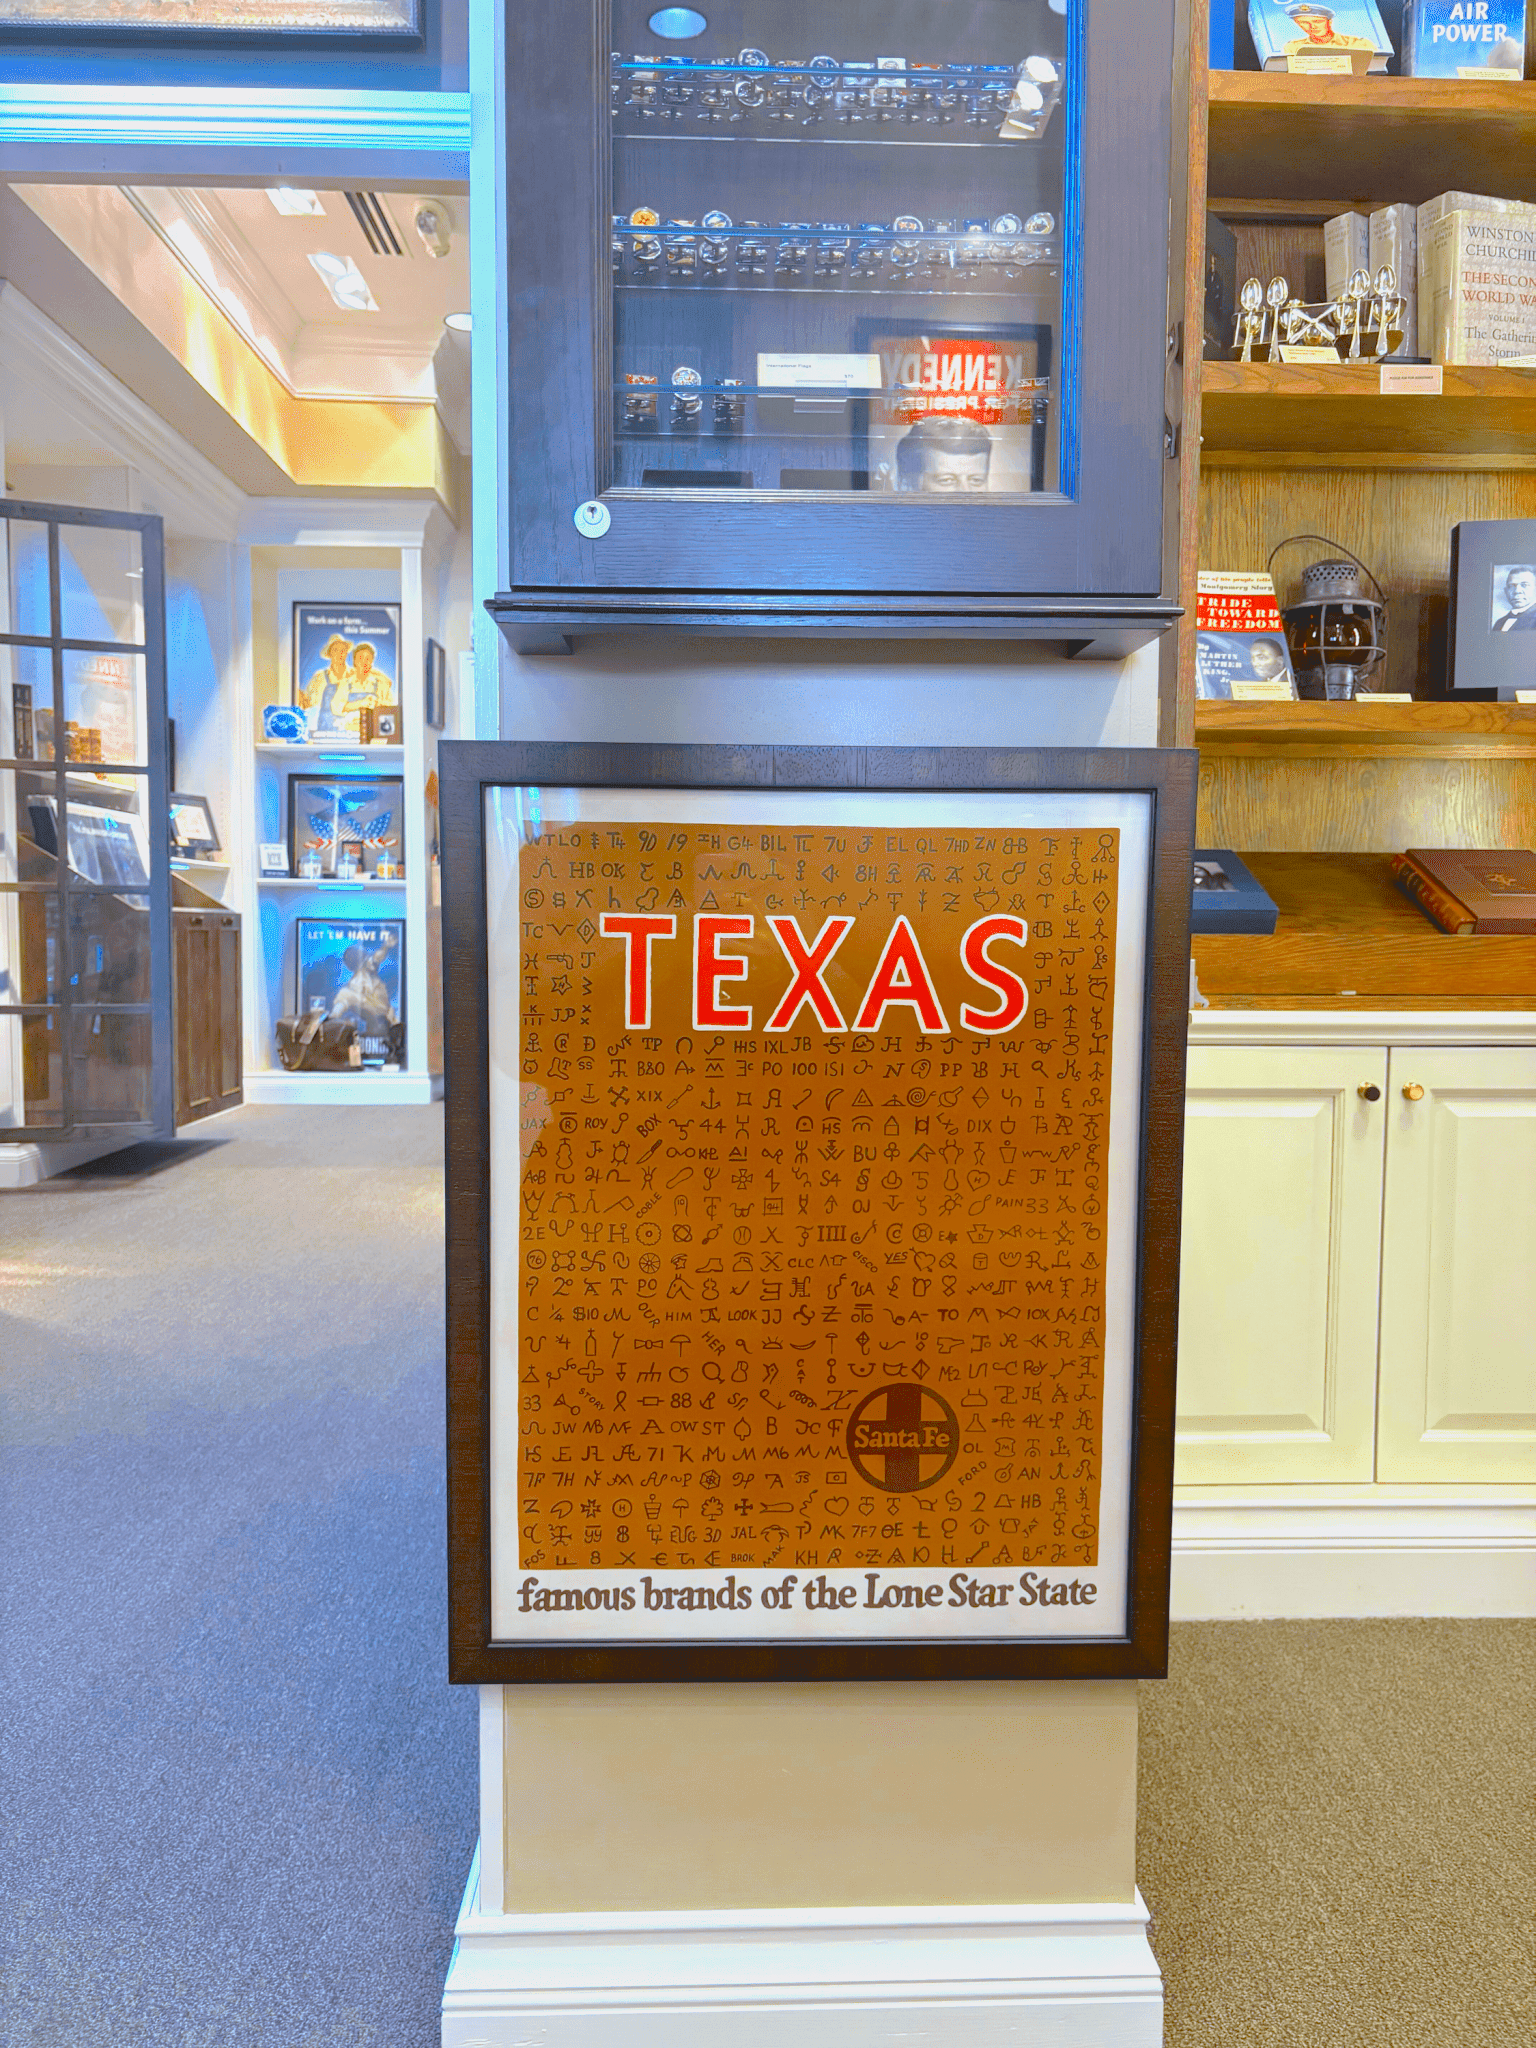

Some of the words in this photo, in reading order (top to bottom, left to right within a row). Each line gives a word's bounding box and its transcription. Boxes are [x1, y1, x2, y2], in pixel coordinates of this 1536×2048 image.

[1450, 2, 1489, 20] AIR
[1433, 24, 1507, 43] POWER
[1467, 226, 1534, 243] WINSTON
[1462, 271, 1490, 284] THE
[1462, 290, 1515, 305] WORLD
[1488, 315, 1521, 323] VOLUME
[1465, 327, 1487, 339] The
[1207, 608, 1280, 619] TOWARD
[1196, 618, 1281, 629] FREEDOM
[1199, 652, 1239, 660] MARTIN
[601, 862, 625, 879] OK
[308, 930, 324, 939] LET
[348, 930, 376, 941] HAVE
[599, 912, 1029, 1035] TEXAS
[584, 1118, 608, 1129] ROY
[968, 1119, 992, 1133] DIX
[728, 1309, 758, 1320] LOOK
[854, 1424, 921, 1448] Santa
[922, 1427, 950, 1448] Fe
[518, 1577, 636, 1612] famous
[640, 1576, 751, 1611] brands
[761, 1575, 798, 1609] of
[802, 1575, 857, 1610] the
[863, 1573, 943, 1609] Lone
[948, 1572, 1014, 1608] Star
[1019, 1572, 1097, 1606] State
